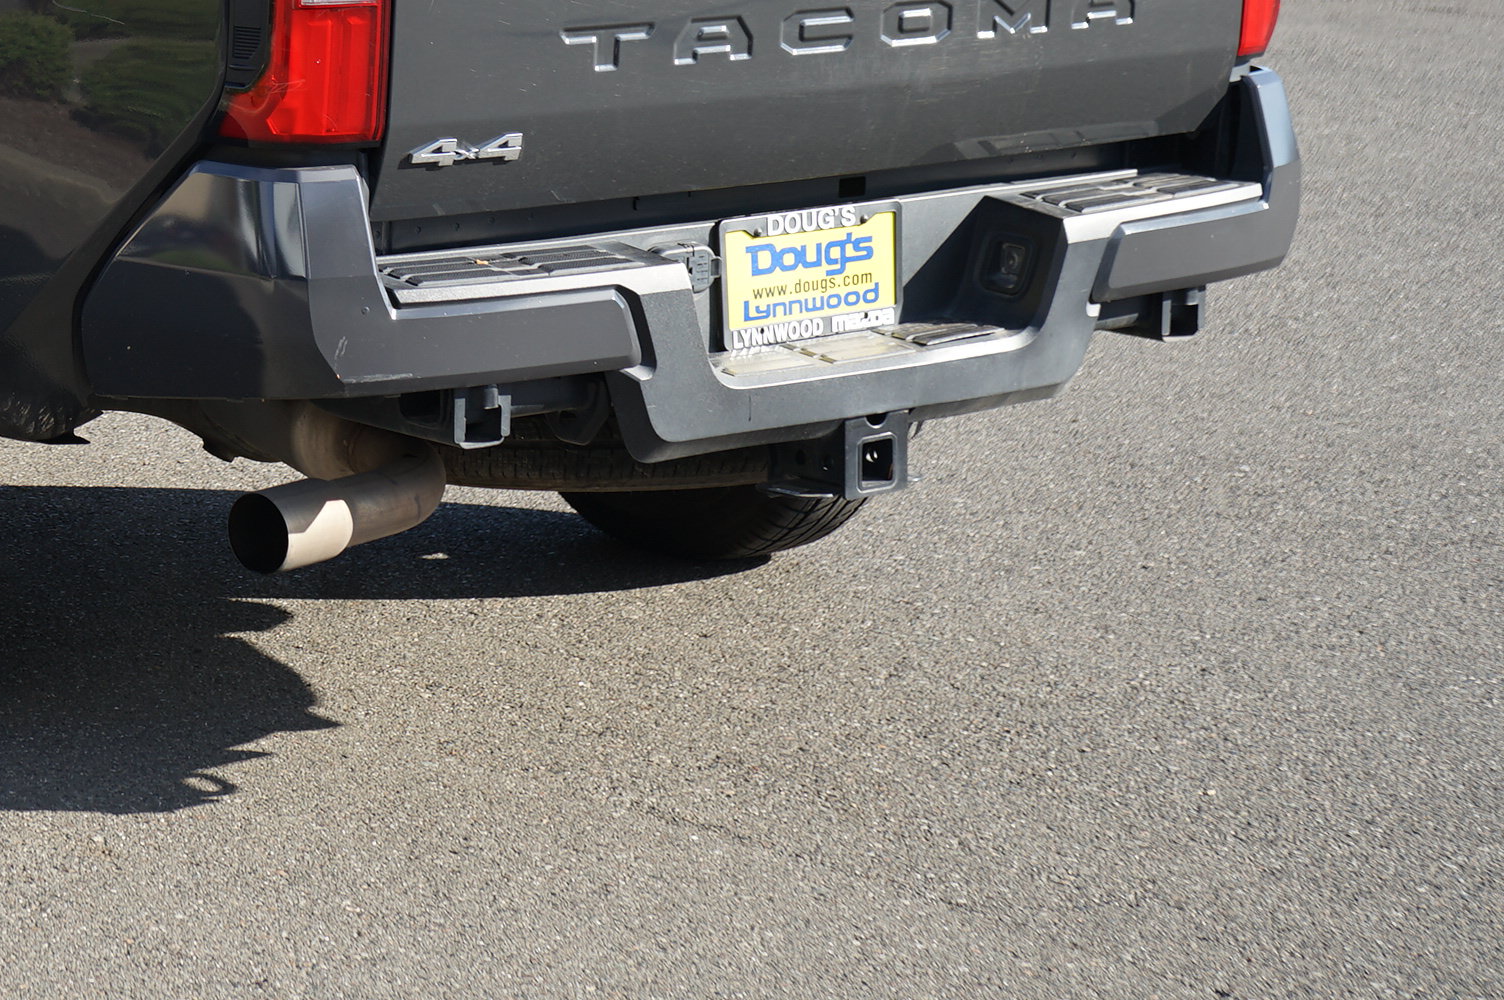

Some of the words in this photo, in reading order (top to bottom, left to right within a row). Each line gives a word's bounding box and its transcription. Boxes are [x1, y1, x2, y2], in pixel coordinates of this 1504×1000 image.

[766, 206, 857, 237] DOUG'S
[745, 232, 874, 277] Doug's
[752, 272, 873, 299] www.dougs.com
[743, 282, 880, 323] Lynnwood
[732, 317, 824, 350] LYNNWOOD
